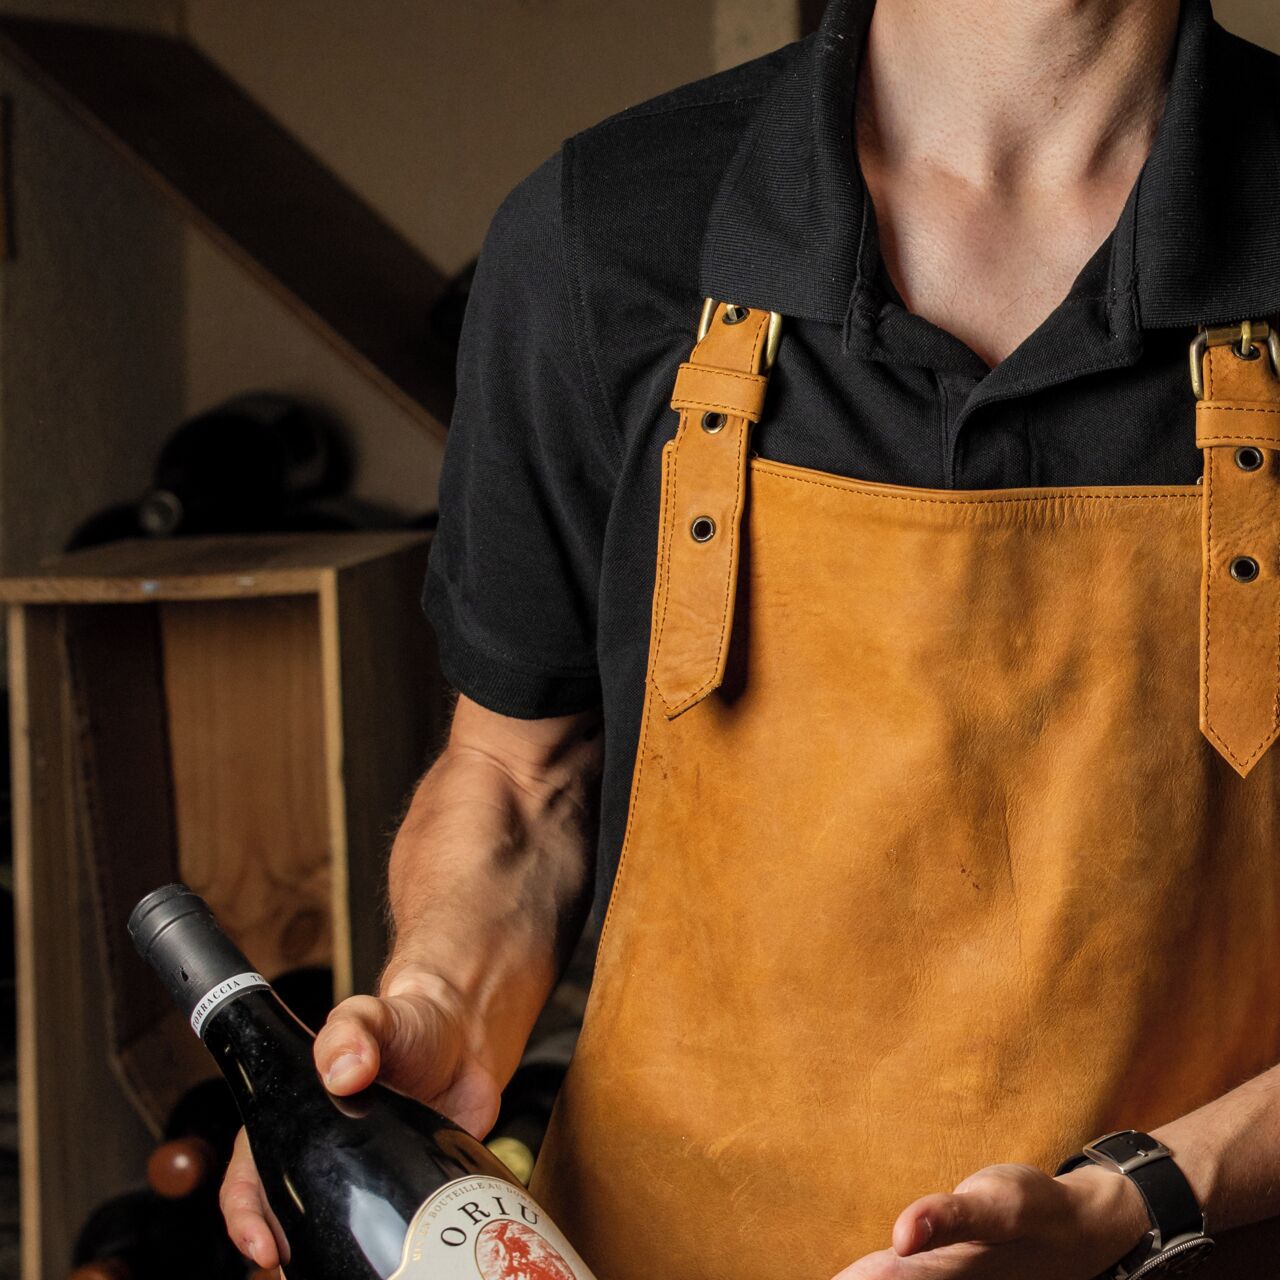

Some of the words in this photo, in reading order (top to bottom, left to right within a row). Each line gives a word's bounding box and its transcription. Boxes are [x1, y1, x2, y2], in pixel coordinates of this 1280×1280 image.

[192, 980, 241, 1030] TORRACCIA
[429, 1182, 486, 1219] BOUTEILLE
[488, 1183, 503, 1192] AU
[440, 1196, 540, 1247] ORIU
